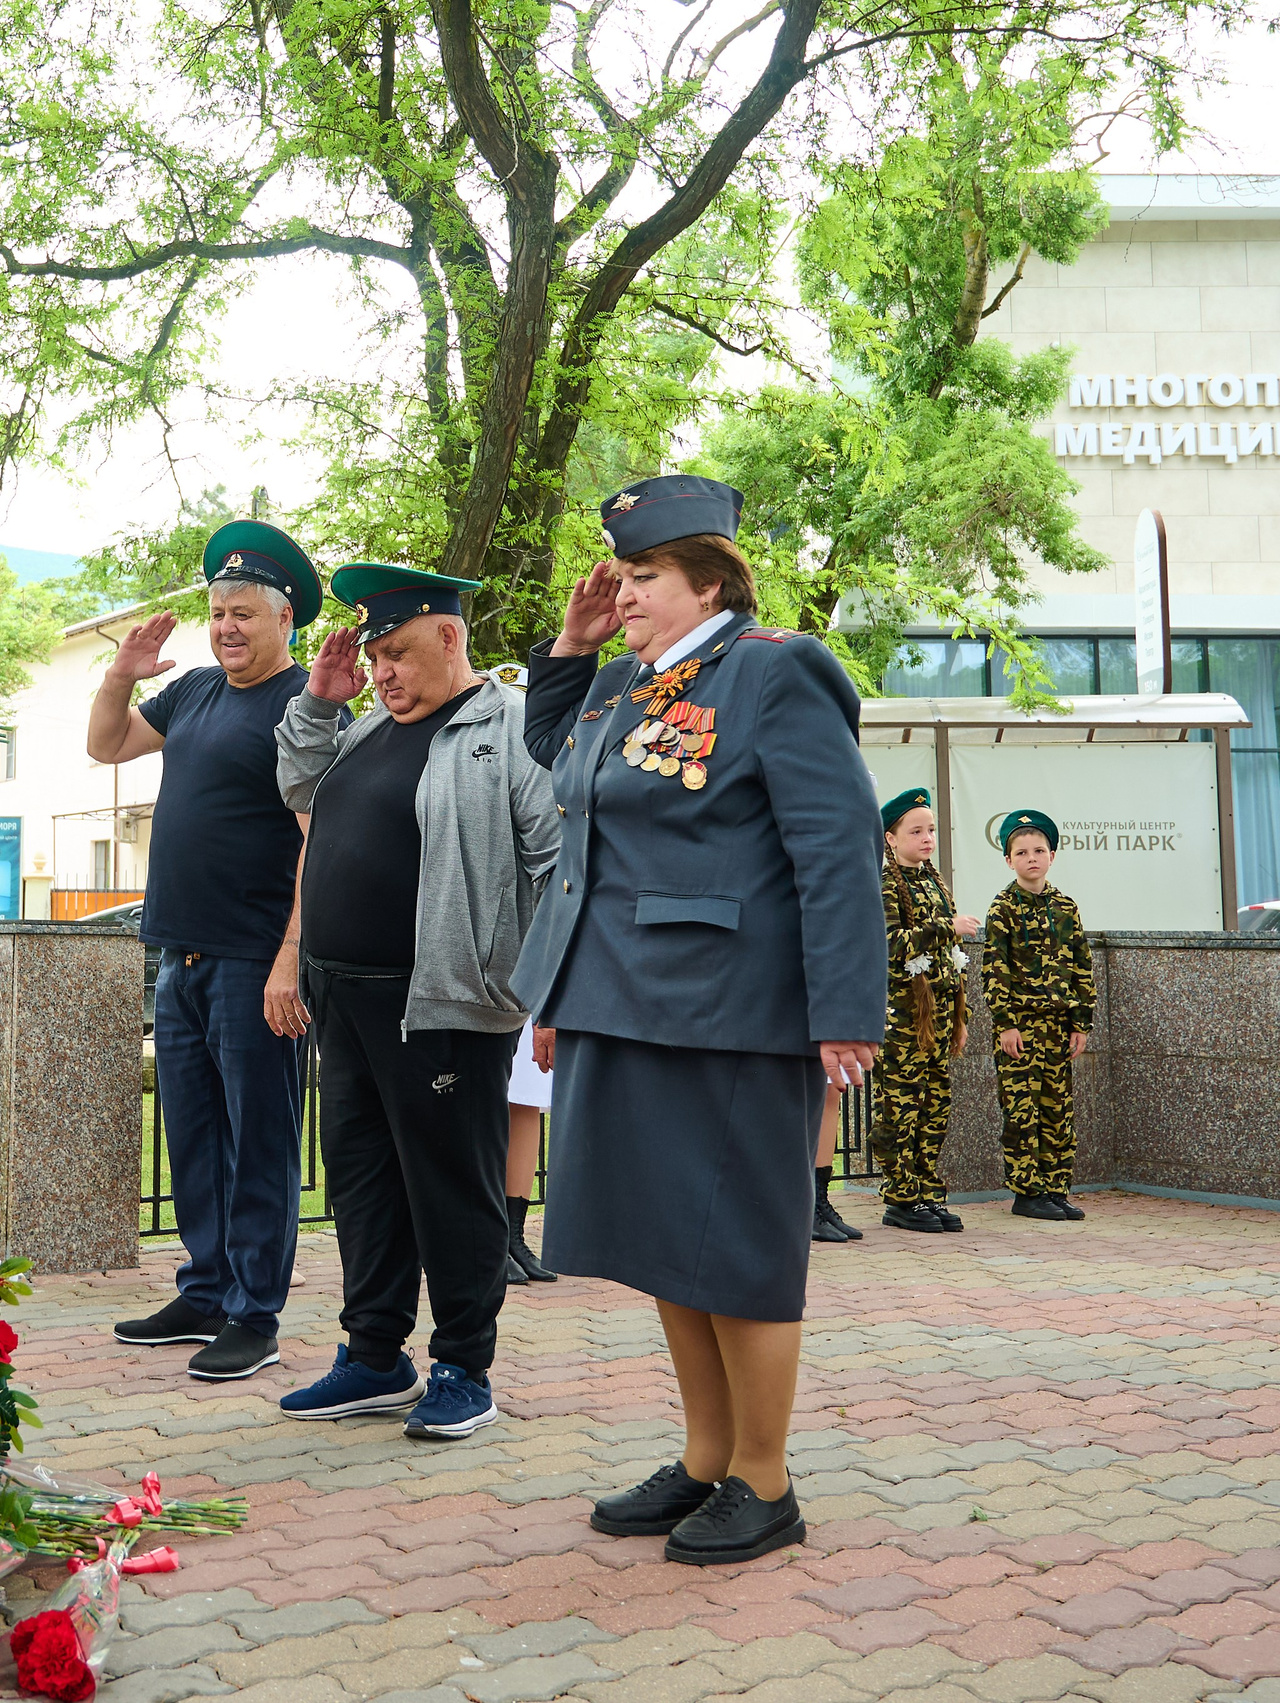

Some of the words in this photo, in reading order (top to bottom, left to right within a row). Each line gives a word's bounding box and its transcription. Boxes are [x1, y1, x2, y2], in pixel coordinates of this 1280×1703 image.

[1070, 374, 1280, 407] МНОГОП
[1055, 422, 1280, 464] МЕДИЦИ
[477, 744, 494, 752] NIKE
[1063, 820, 1136, 830] КУЛЬТУРНЫЙ
[1140, 822, 1175, 830] ЦЕНТР
[1117, 835, 1176, 850] ПАРК
[437, 1073, 455, 1084] NIKE
